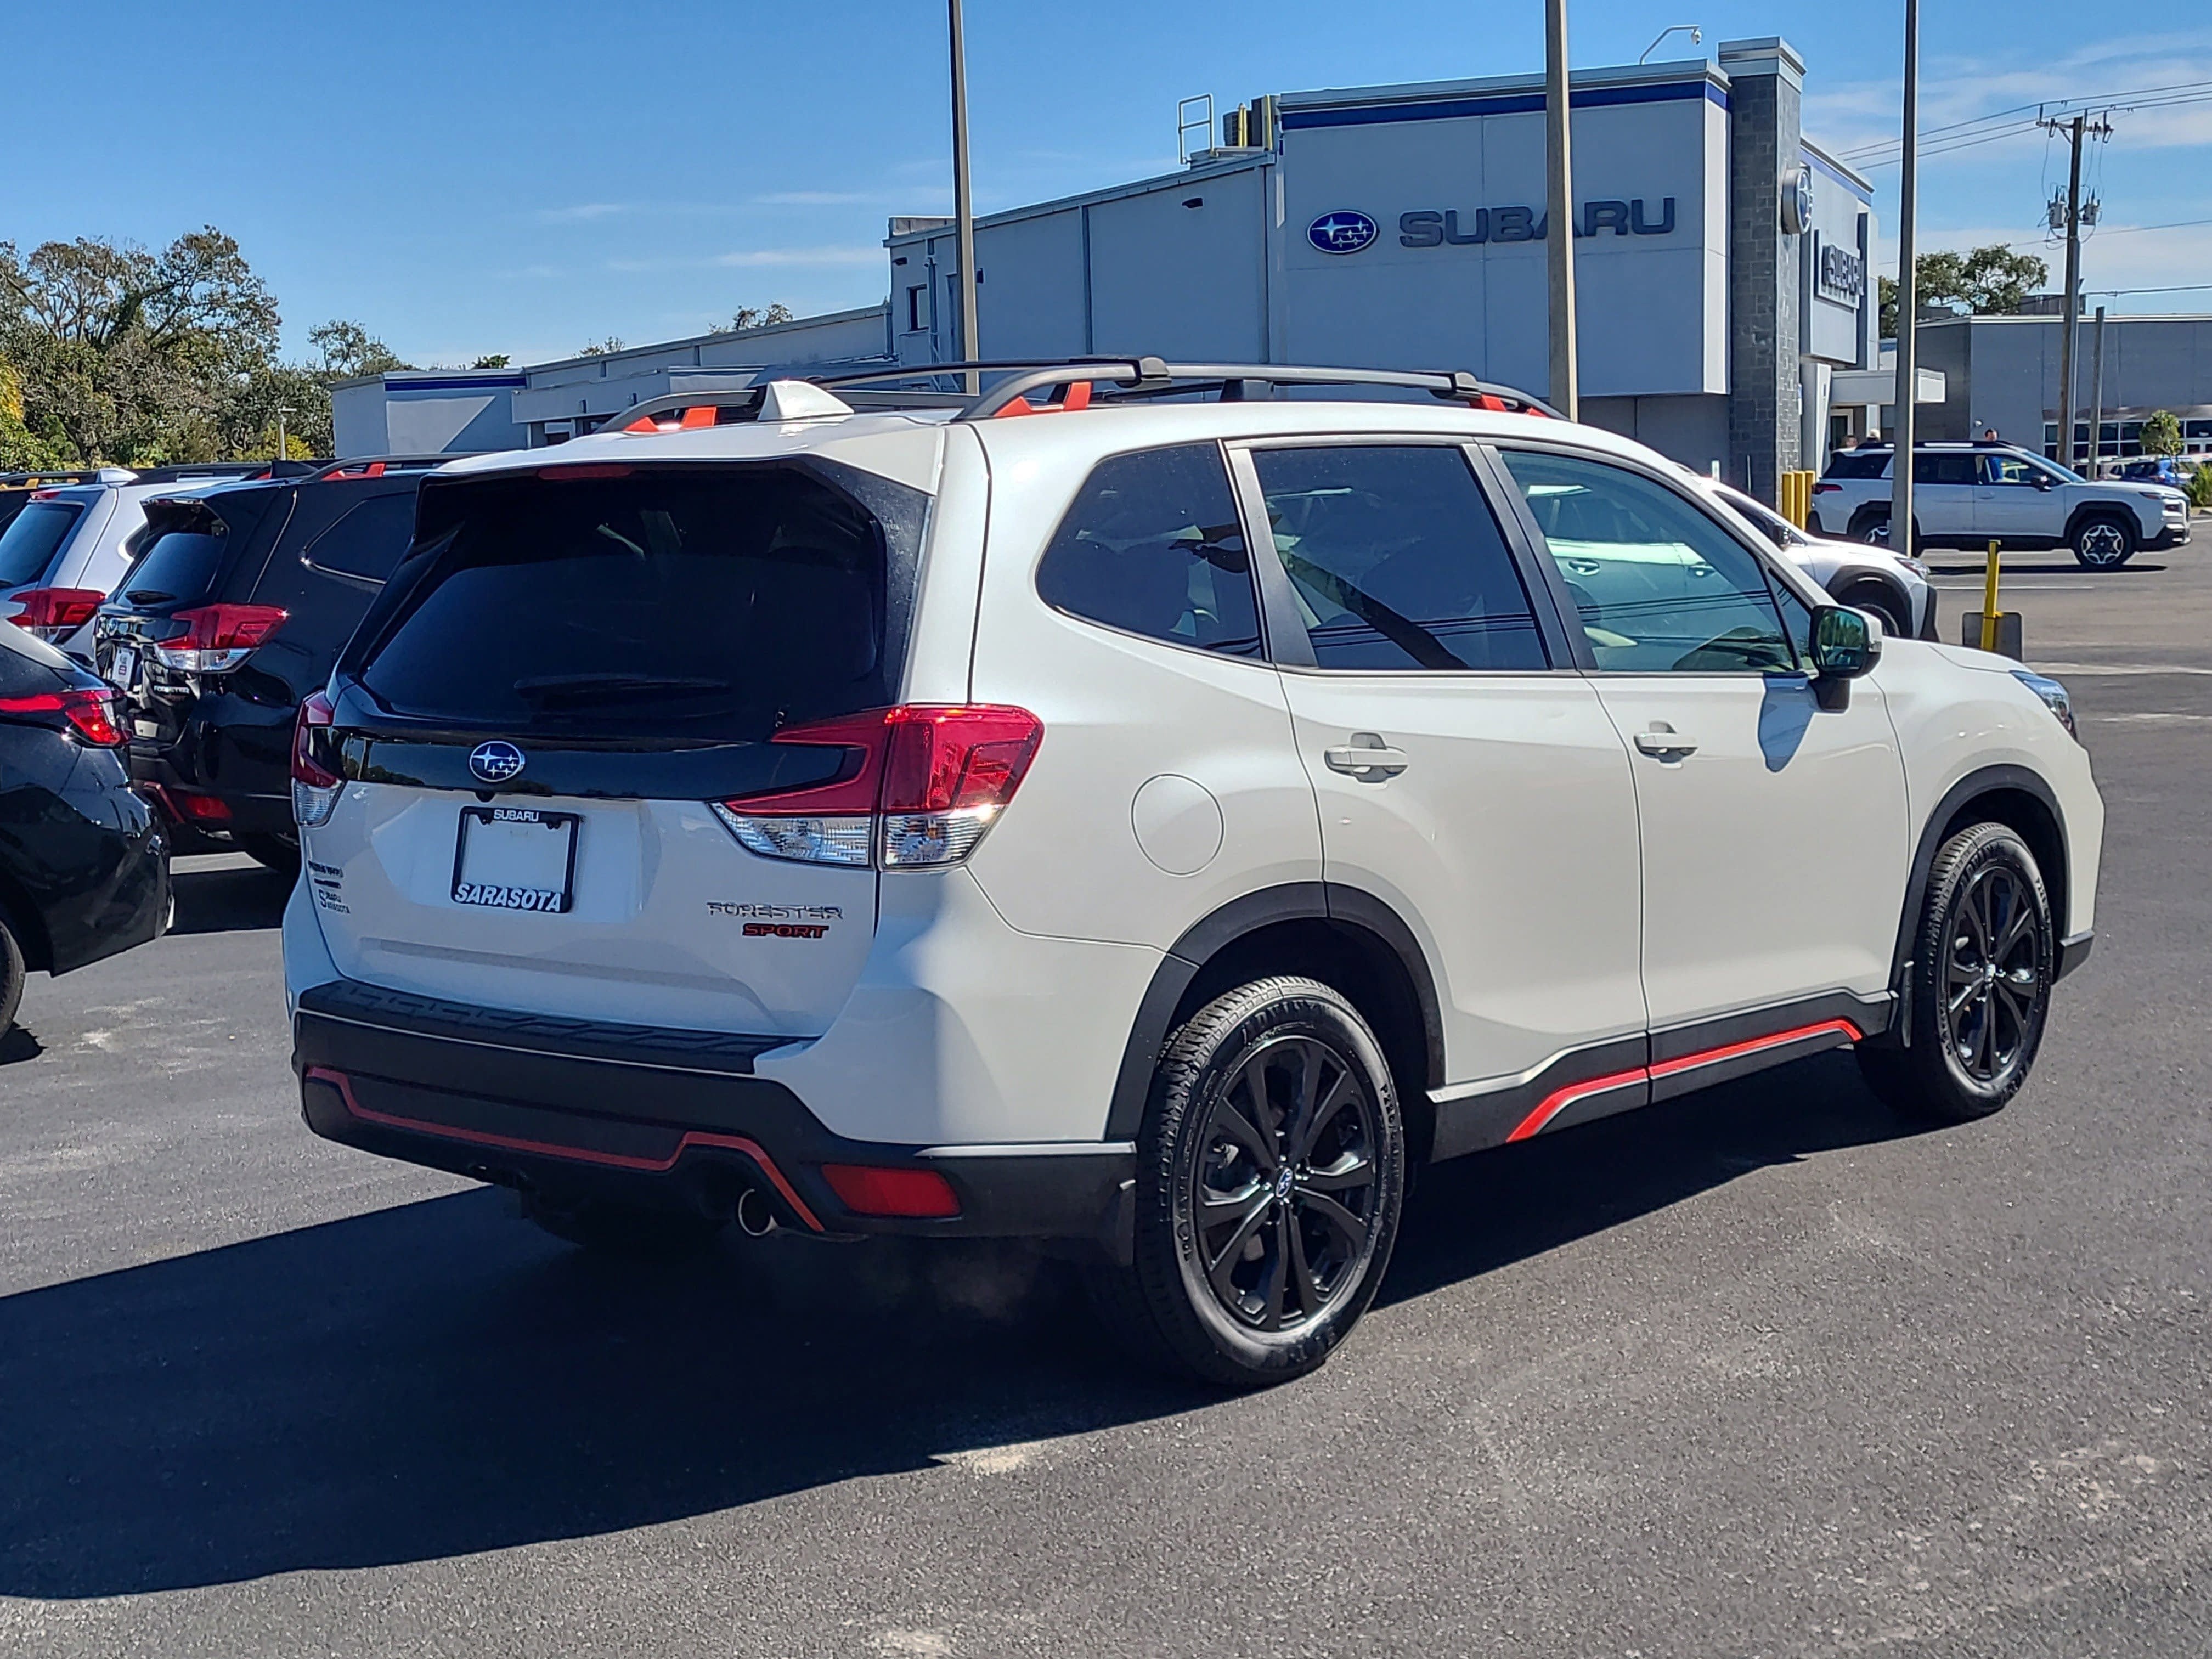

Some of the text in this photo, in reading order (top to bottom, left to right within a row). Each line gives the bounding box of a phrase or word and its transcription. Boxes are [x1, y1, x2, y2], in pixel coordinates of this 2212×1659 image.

[494, 809, 539, 822] SUBARU
[455, 883, 561, 912] SARASOTA
[706, 901, 844, 919] FORESTER
[742, 923, 830, 939] SPORT
